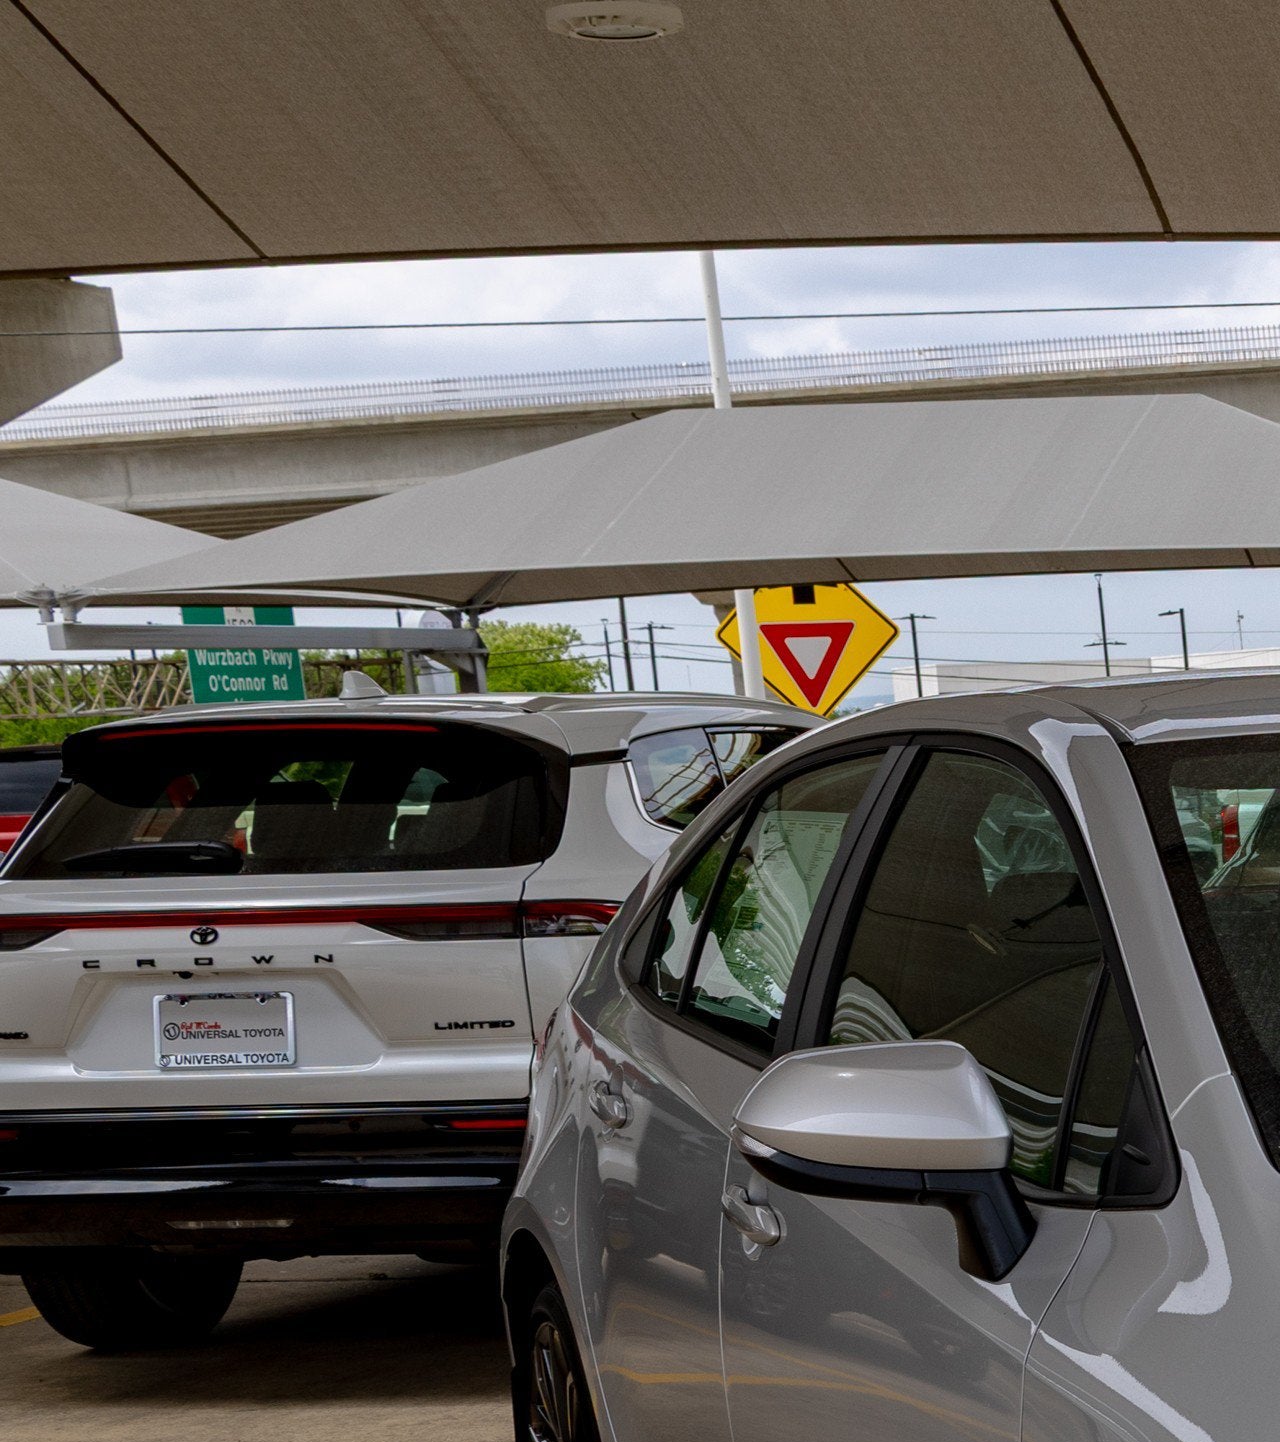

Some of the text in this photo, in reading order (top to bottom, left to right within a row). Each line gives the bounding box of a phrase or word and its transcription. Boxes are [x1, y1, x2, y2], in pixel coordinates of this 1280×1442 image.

[194, 649, 293, 670] Wurzbach Pkwy
[209, 674, 289, 692] O'Connor Rd
[82, 954, 334, 969] CROWN
[434, 1020, 515, 1030] LIMITED
[181, 1028, 285, 1040] UNIVERSAL TOYOTA
[175, 1053, 290, 1065] UNIVERSAL TOYOTA
